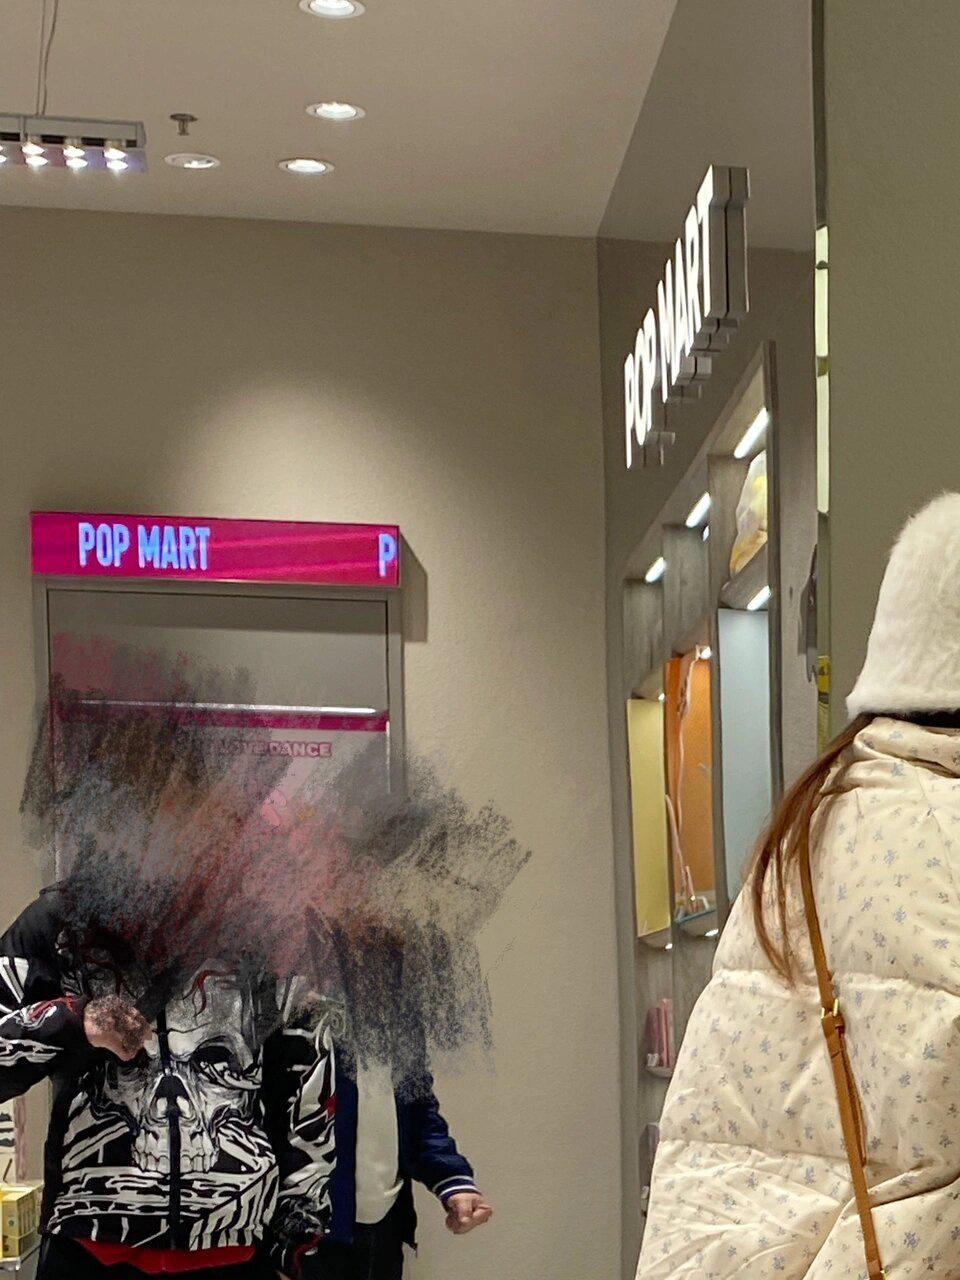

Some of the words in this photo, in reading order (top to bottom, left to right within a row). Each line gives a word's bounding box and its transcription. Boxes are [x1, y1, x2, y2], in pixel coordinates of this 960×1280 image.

[624, 307, 656, 469] POP
[656, 163, 714, 403] MART
[78, 522, 130, 567] POP
[137, 524, 211, 571] MART
[267, 741, 333, 758] DANCE
